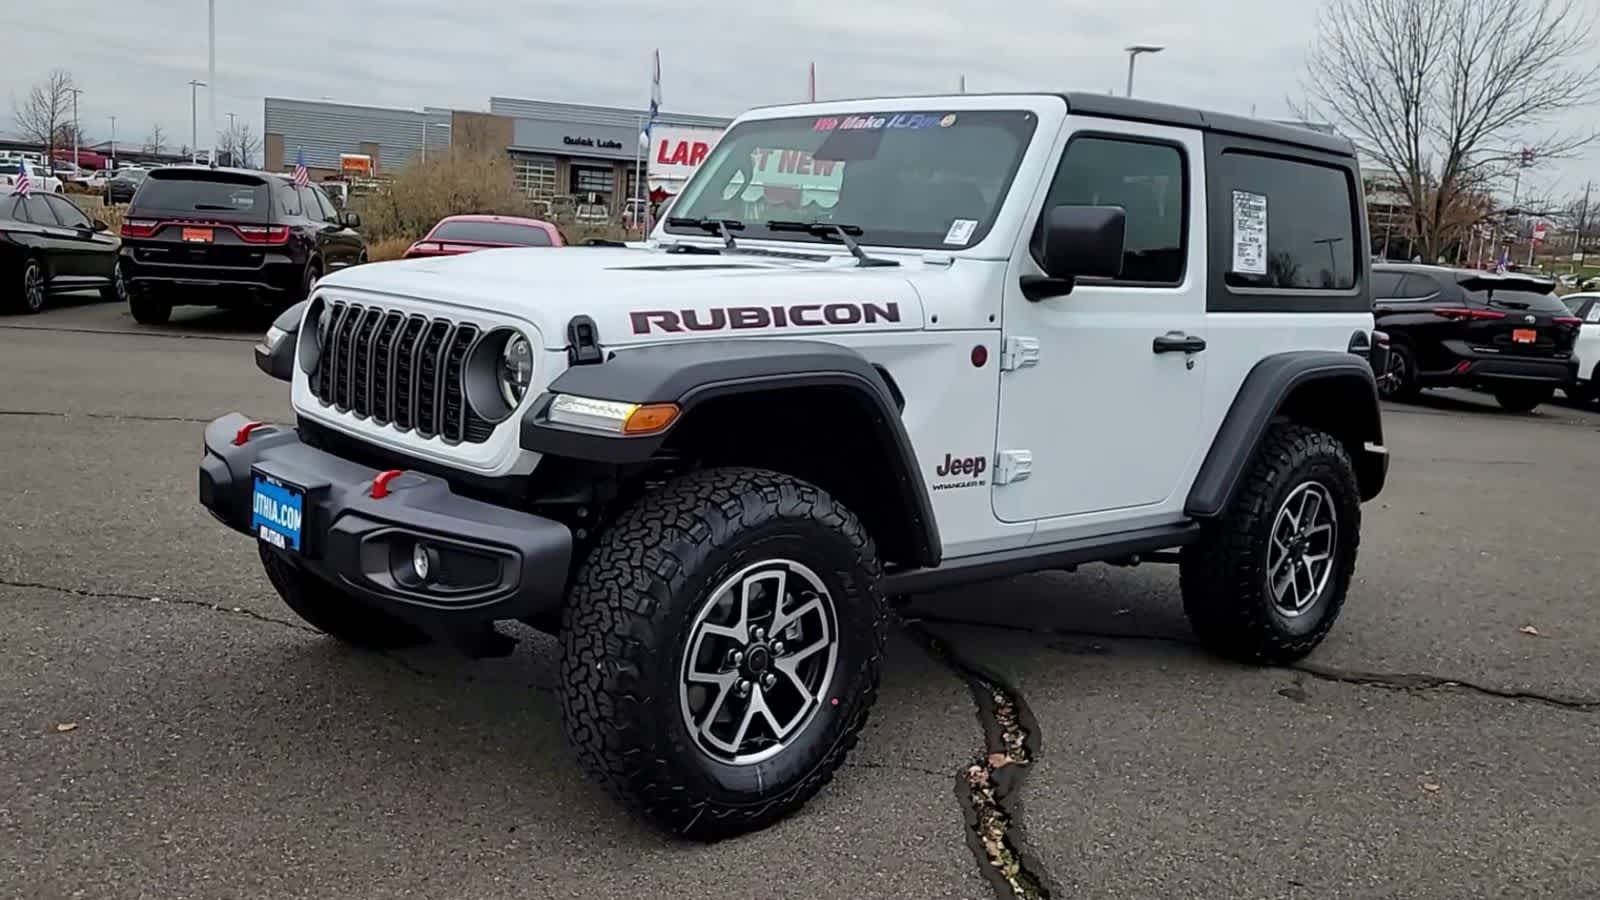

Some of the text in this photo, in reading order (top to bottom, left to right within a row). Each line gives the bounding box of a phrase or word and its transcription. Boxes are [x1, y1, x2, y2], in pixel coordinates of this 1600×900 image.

[839, 114, 886, 129] Make
[563, 135, 623, 150] Quick Lube
[629, 302, 901, 335] RUBICON
[936, 453, 986, 478] Jeep
